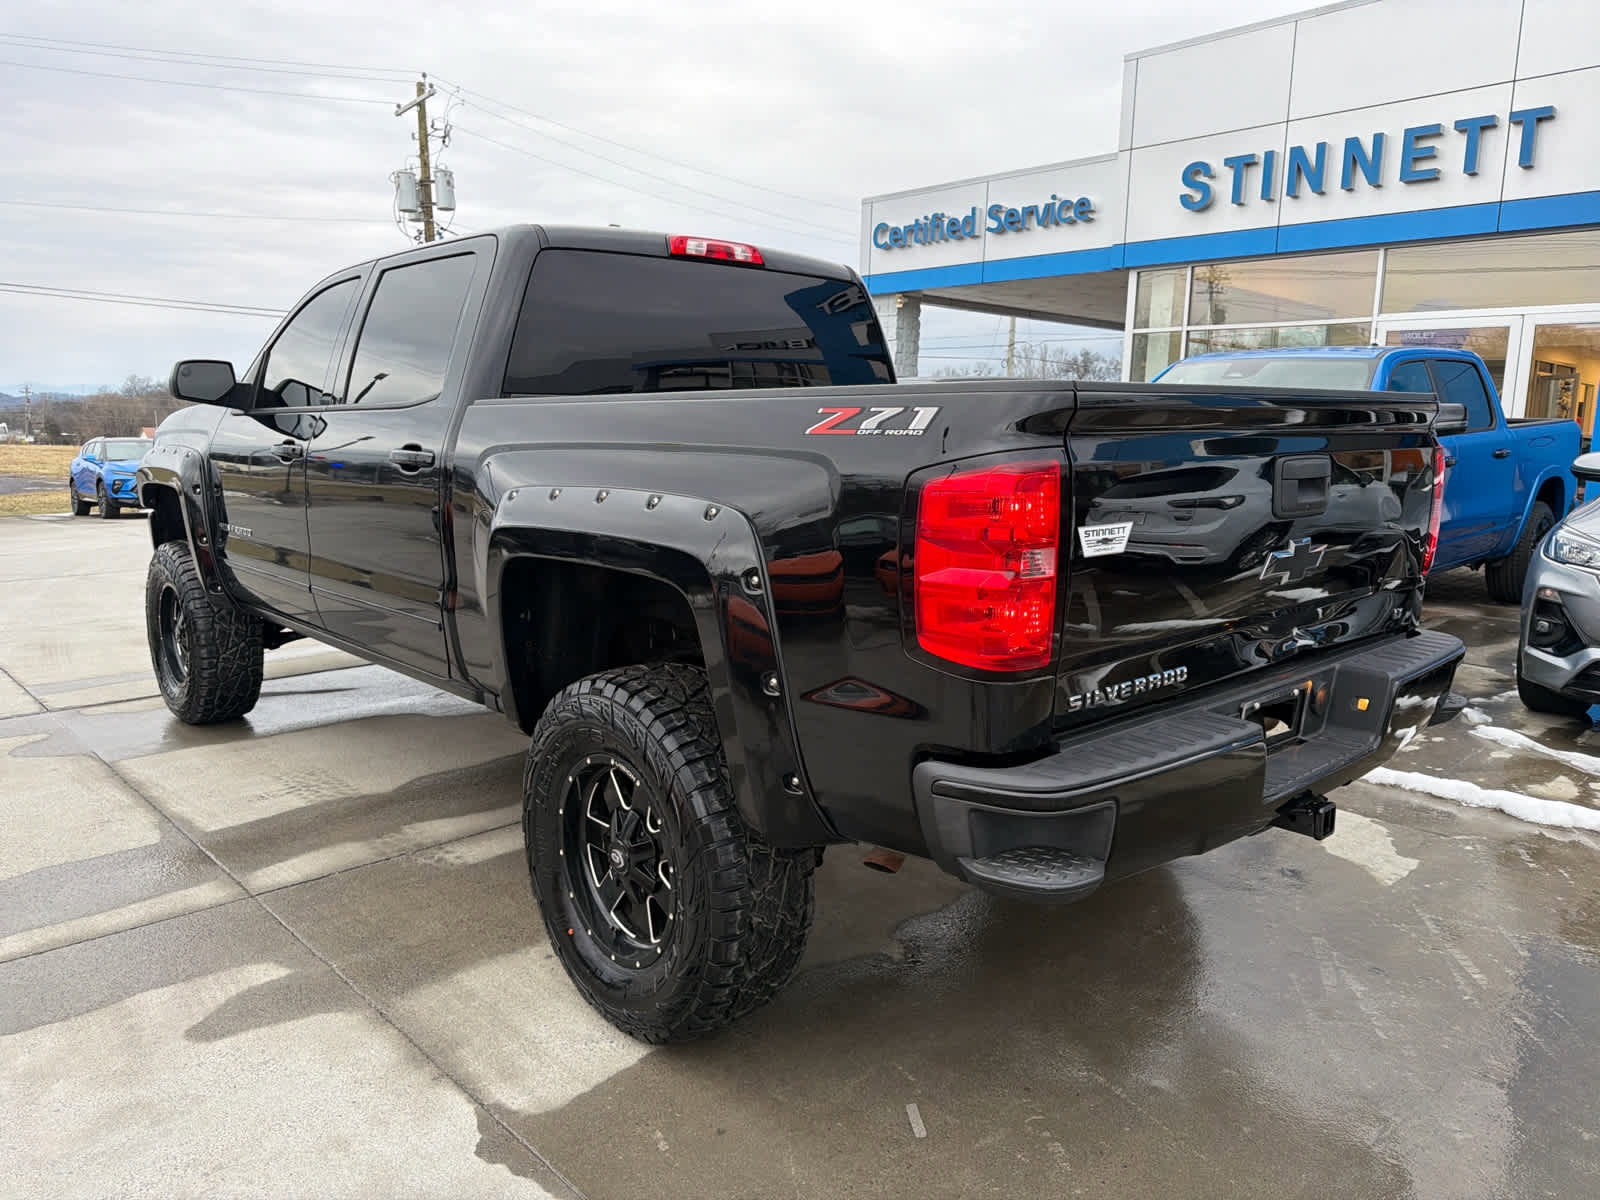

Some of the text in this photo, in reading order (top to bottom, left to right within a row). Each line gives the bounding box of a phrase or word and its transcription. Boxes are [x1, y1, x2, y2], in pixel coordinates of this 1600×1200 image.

[1179, 105, 1556, 212] STINNETT
[873, 193, 1094, 250] Certified Service
[804, 406, 940, 435] Z71
[1084, 526, 1127, 538] STINNETT
[1068, 665, 1188, 713] SILVERADO
